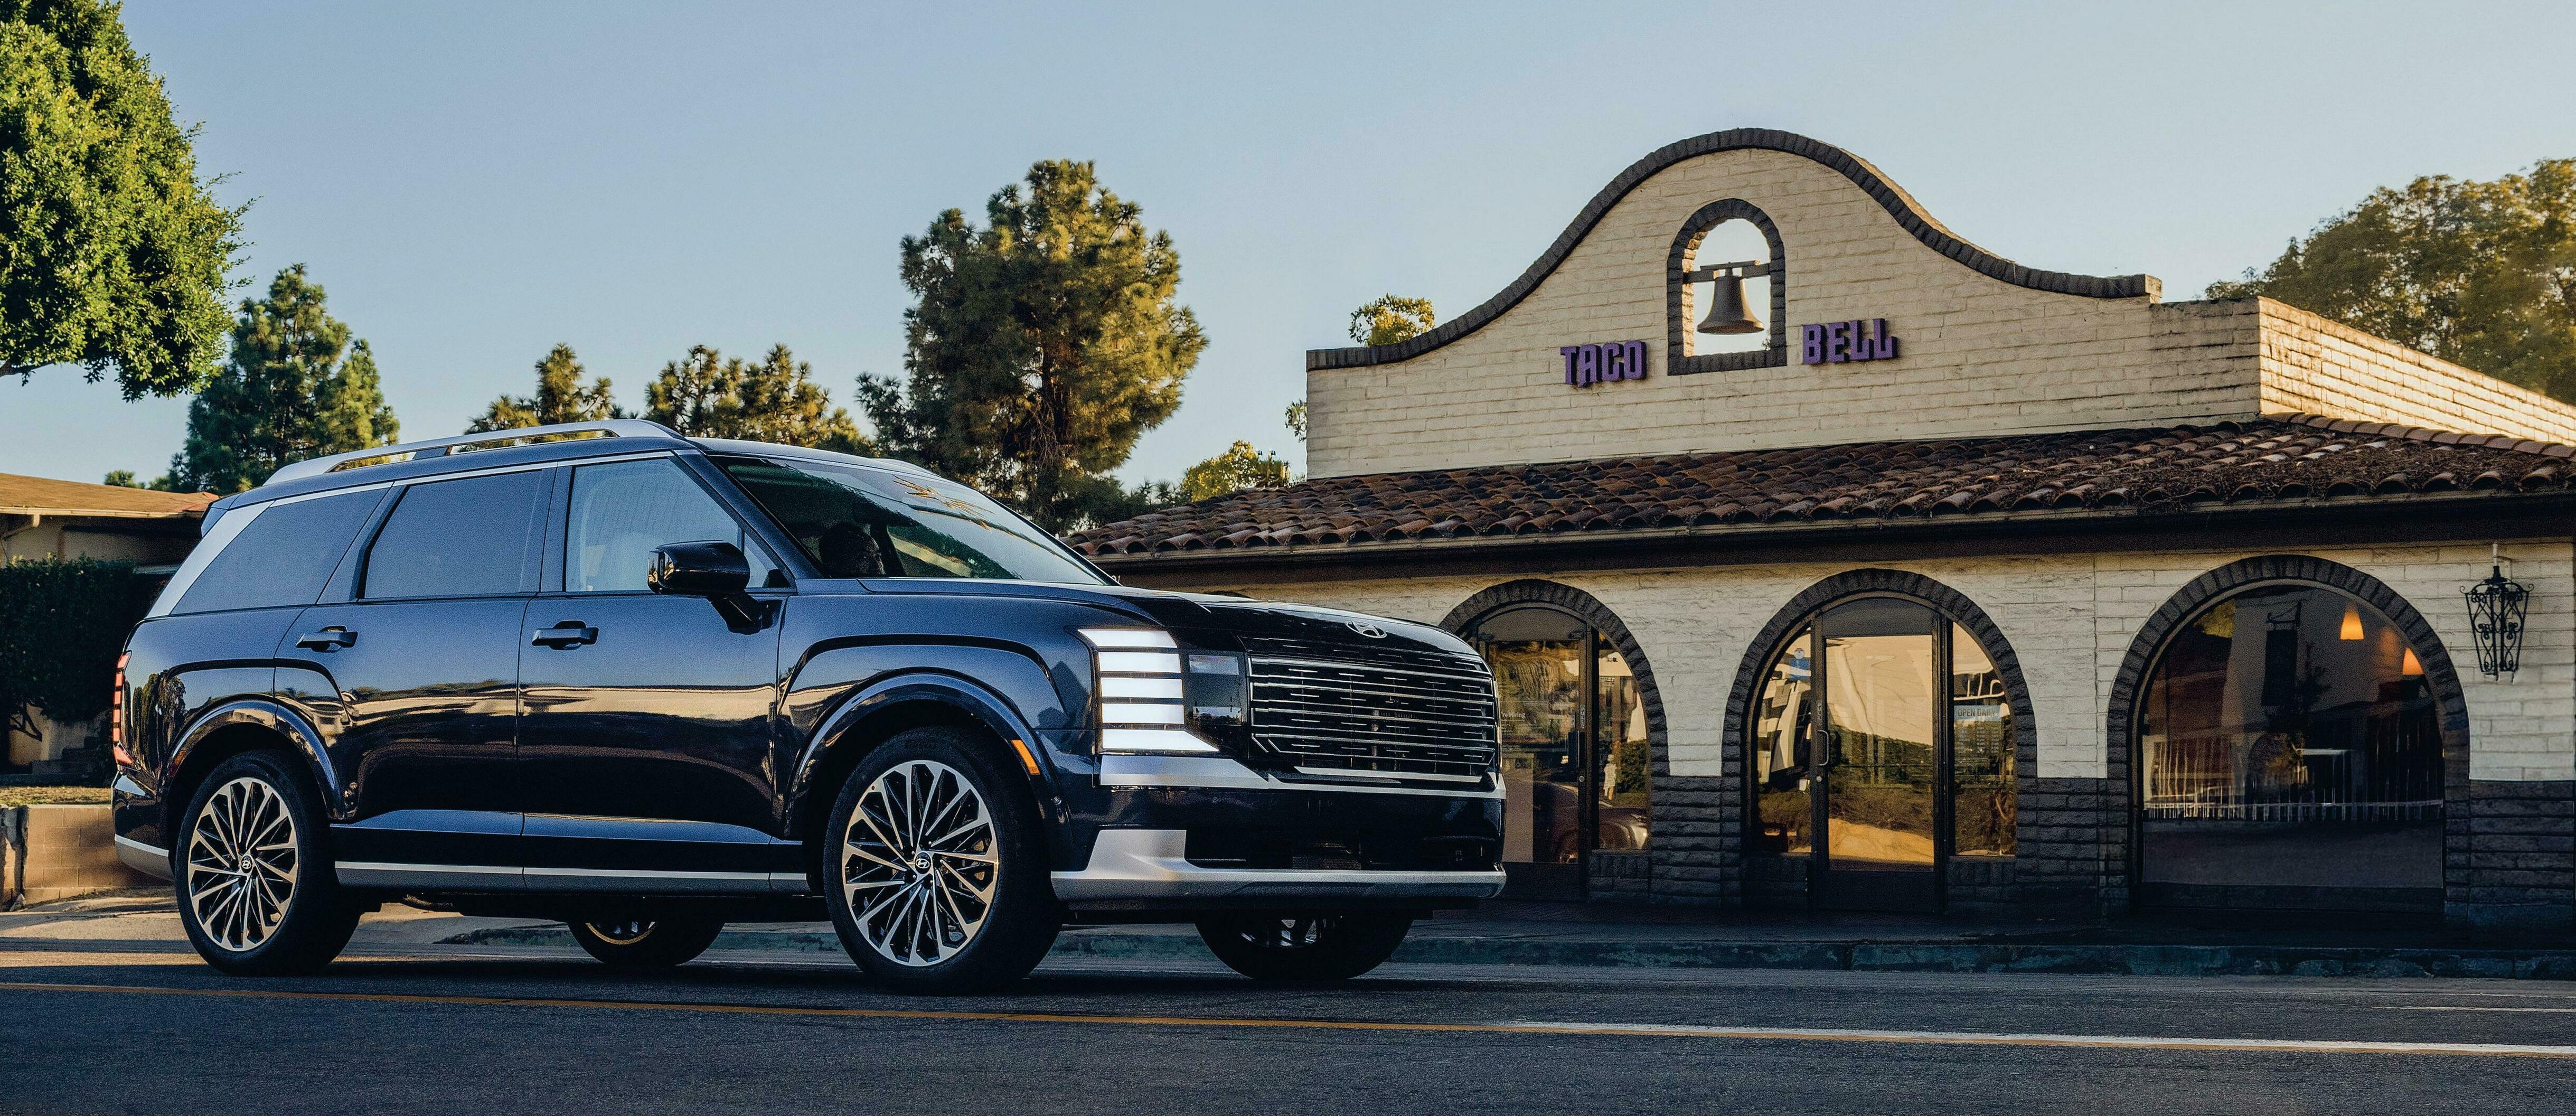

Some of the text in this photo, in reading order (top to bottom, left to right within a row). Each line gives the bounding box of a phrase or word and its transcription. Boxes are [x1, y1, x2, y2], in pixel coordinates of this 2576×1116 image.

[1560, 318, 1897, 388] TACO BELL
[1958, 708, 1975, 717] OPEN
